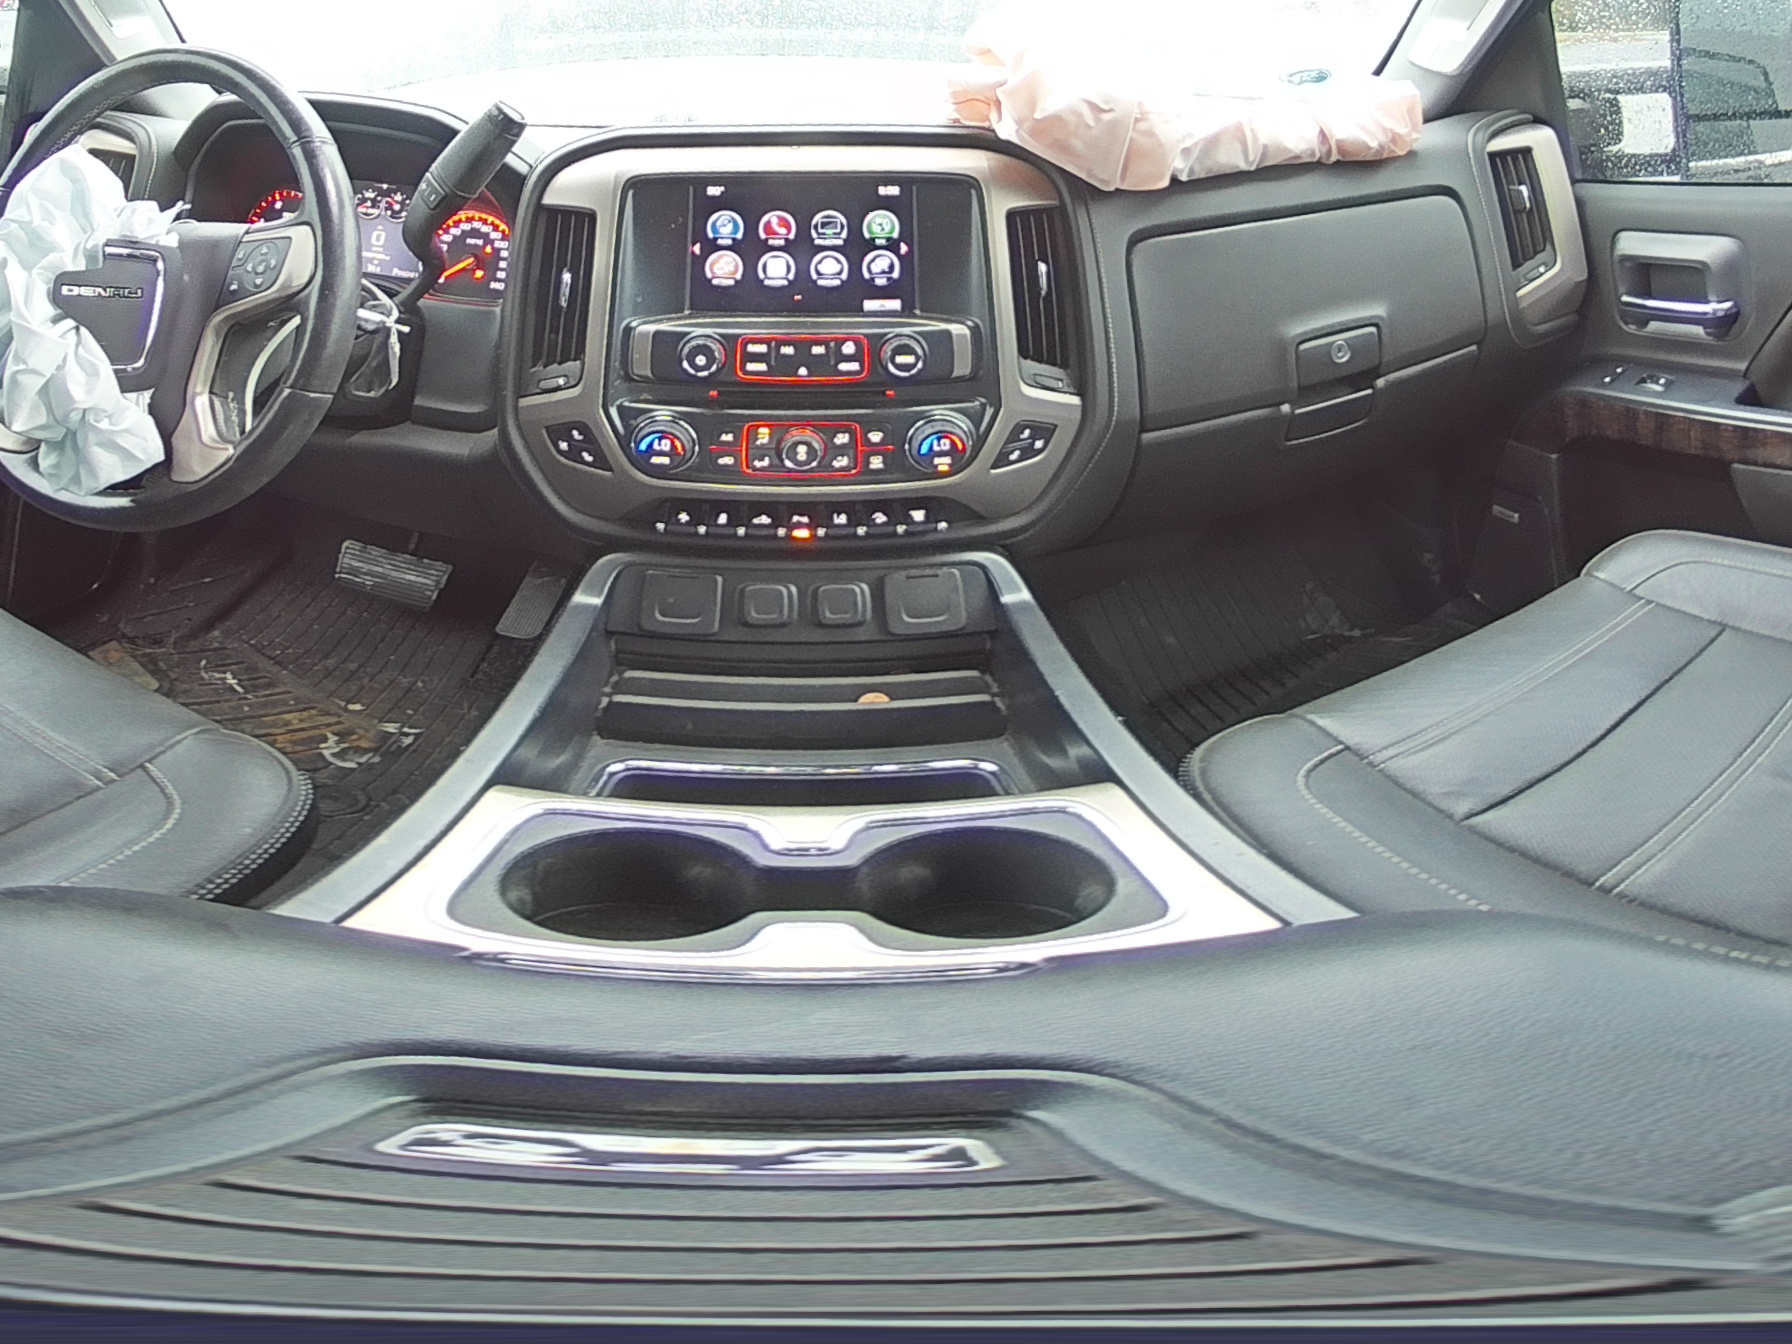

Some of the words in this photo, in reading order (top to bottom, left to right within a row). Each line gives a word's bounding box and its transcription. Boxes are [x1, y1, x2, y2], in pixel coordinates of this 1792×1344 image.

[61, 285, 143, 298] DENALI
[653, 438, 671, 451] LO
[933, 438, 950, 451] LO
